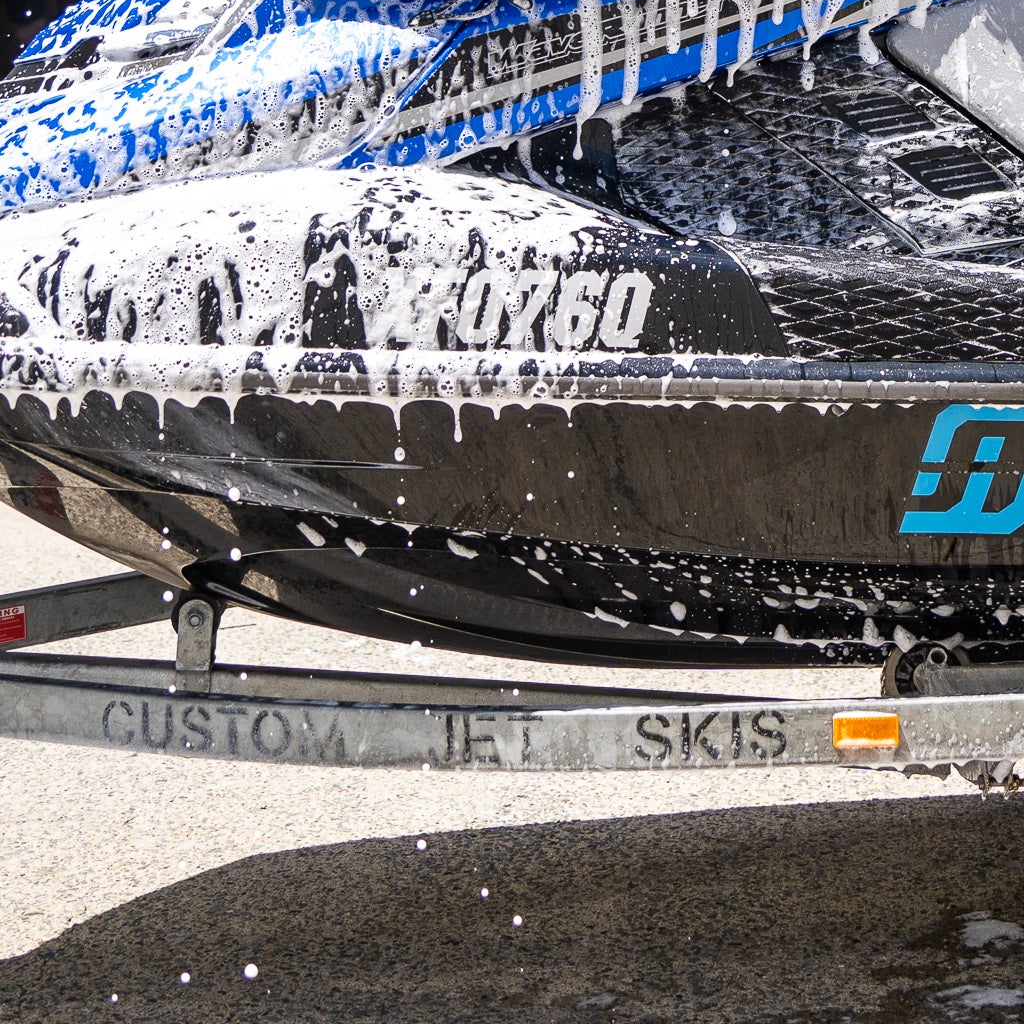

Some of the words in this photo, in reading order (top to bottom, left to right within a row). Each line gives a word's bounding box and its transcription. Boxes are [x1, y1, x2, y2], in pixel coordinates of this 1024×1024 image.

[102, 700, 346, 761] CUSTOM
[429, 713, 544, 764] JET
[635, 710, 787, 761] SKIS
